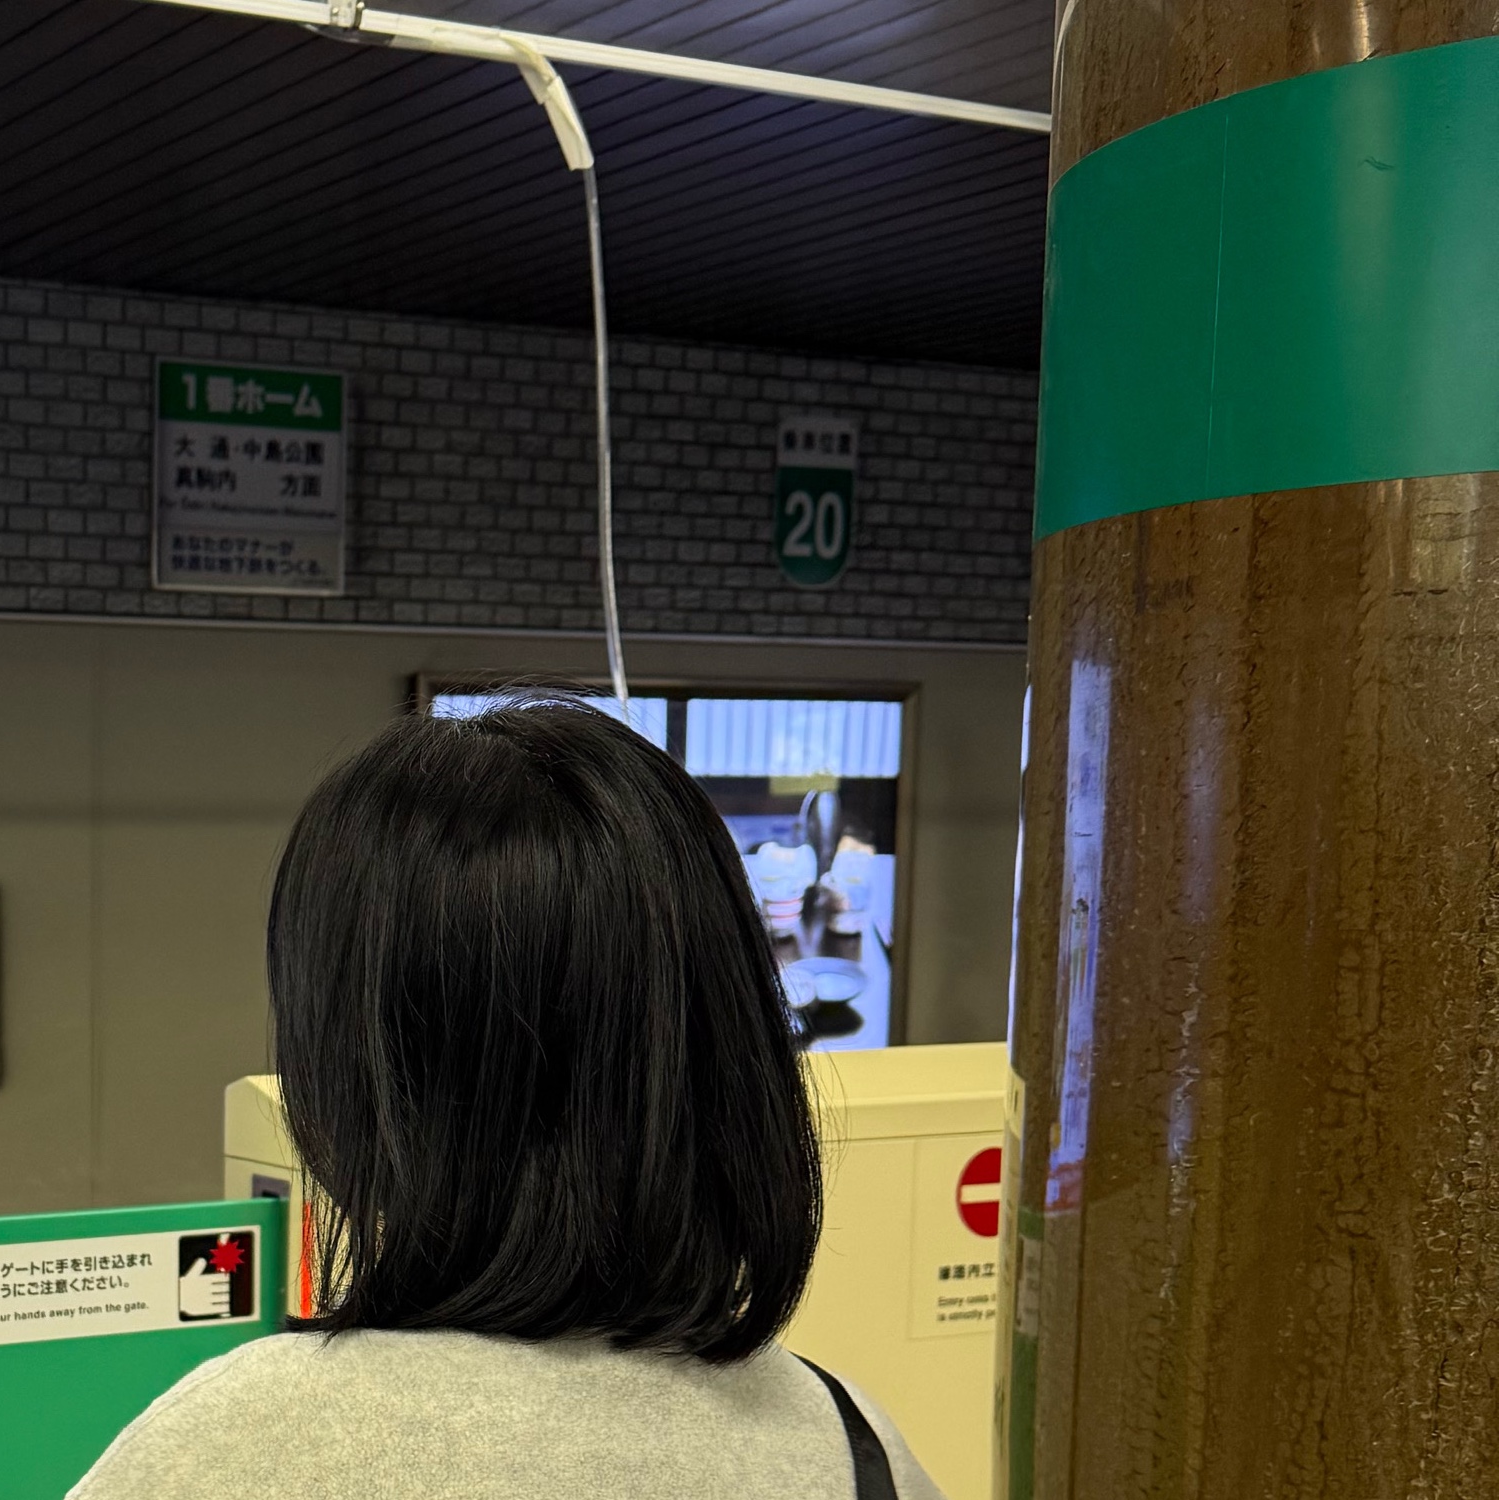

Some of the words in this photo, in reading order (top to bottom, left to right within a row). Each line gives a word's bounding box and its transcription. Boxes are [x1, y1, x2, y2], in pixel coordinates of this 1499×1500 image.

[782, 490, 844, 559] 20
[14, 1308, 46, 1320] hands
[49, 1307, 76, 1320] away
[78, 1304, 103, 1315] from
[105, 1302, 123, 1312] the
[124, 1300, 150, 1313] gate.
